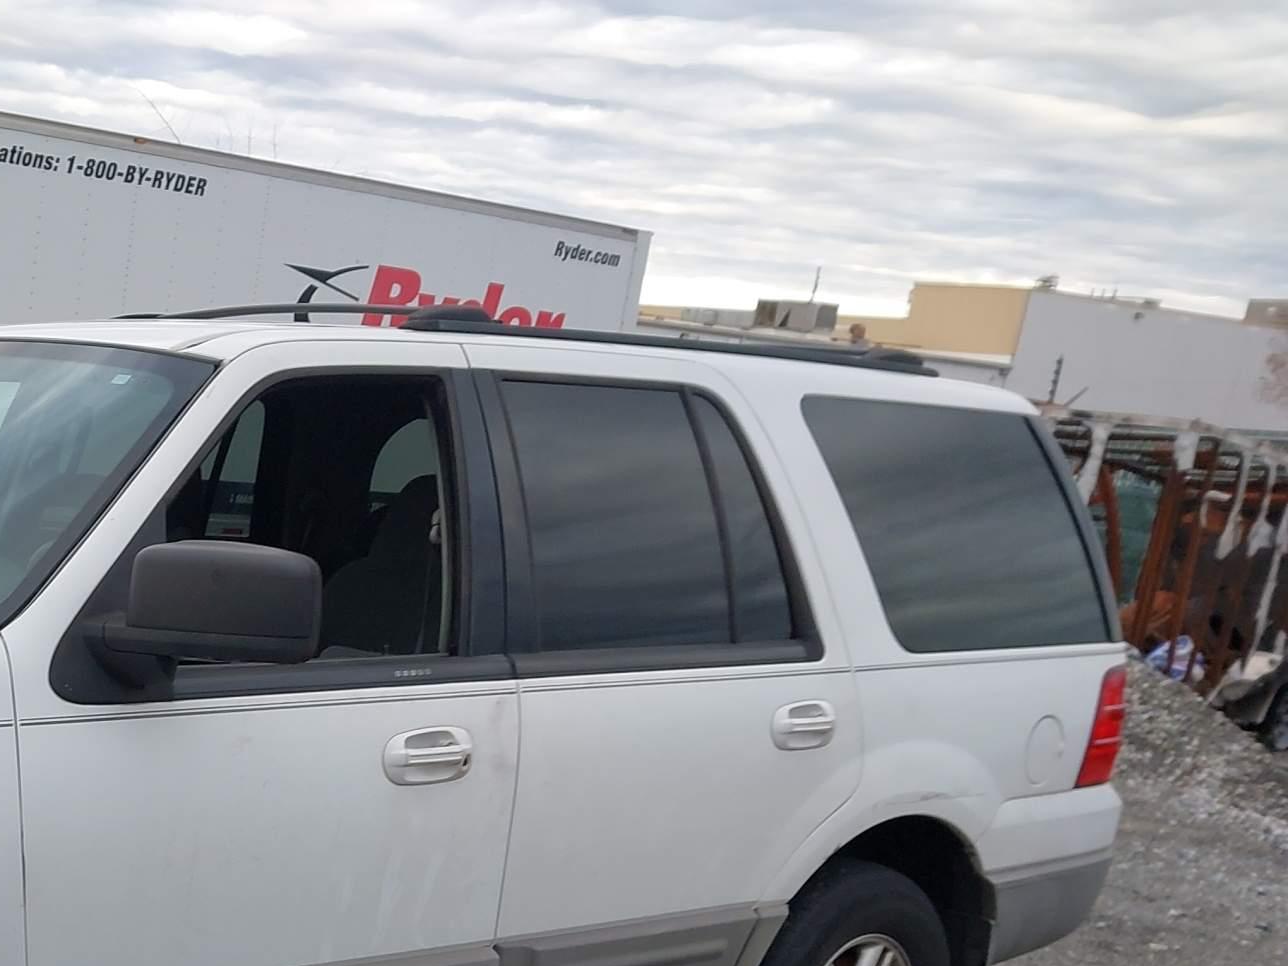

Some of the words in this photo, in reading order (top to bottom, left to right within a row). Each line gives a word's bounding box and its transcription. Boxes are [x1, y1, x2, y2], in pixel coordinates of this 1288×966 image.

[66, 155, 208, 197] 1-800-BY-RYDER
[553, 240, 621, 267] Ryder.com
[360, 264, 566, 328] Rdr
